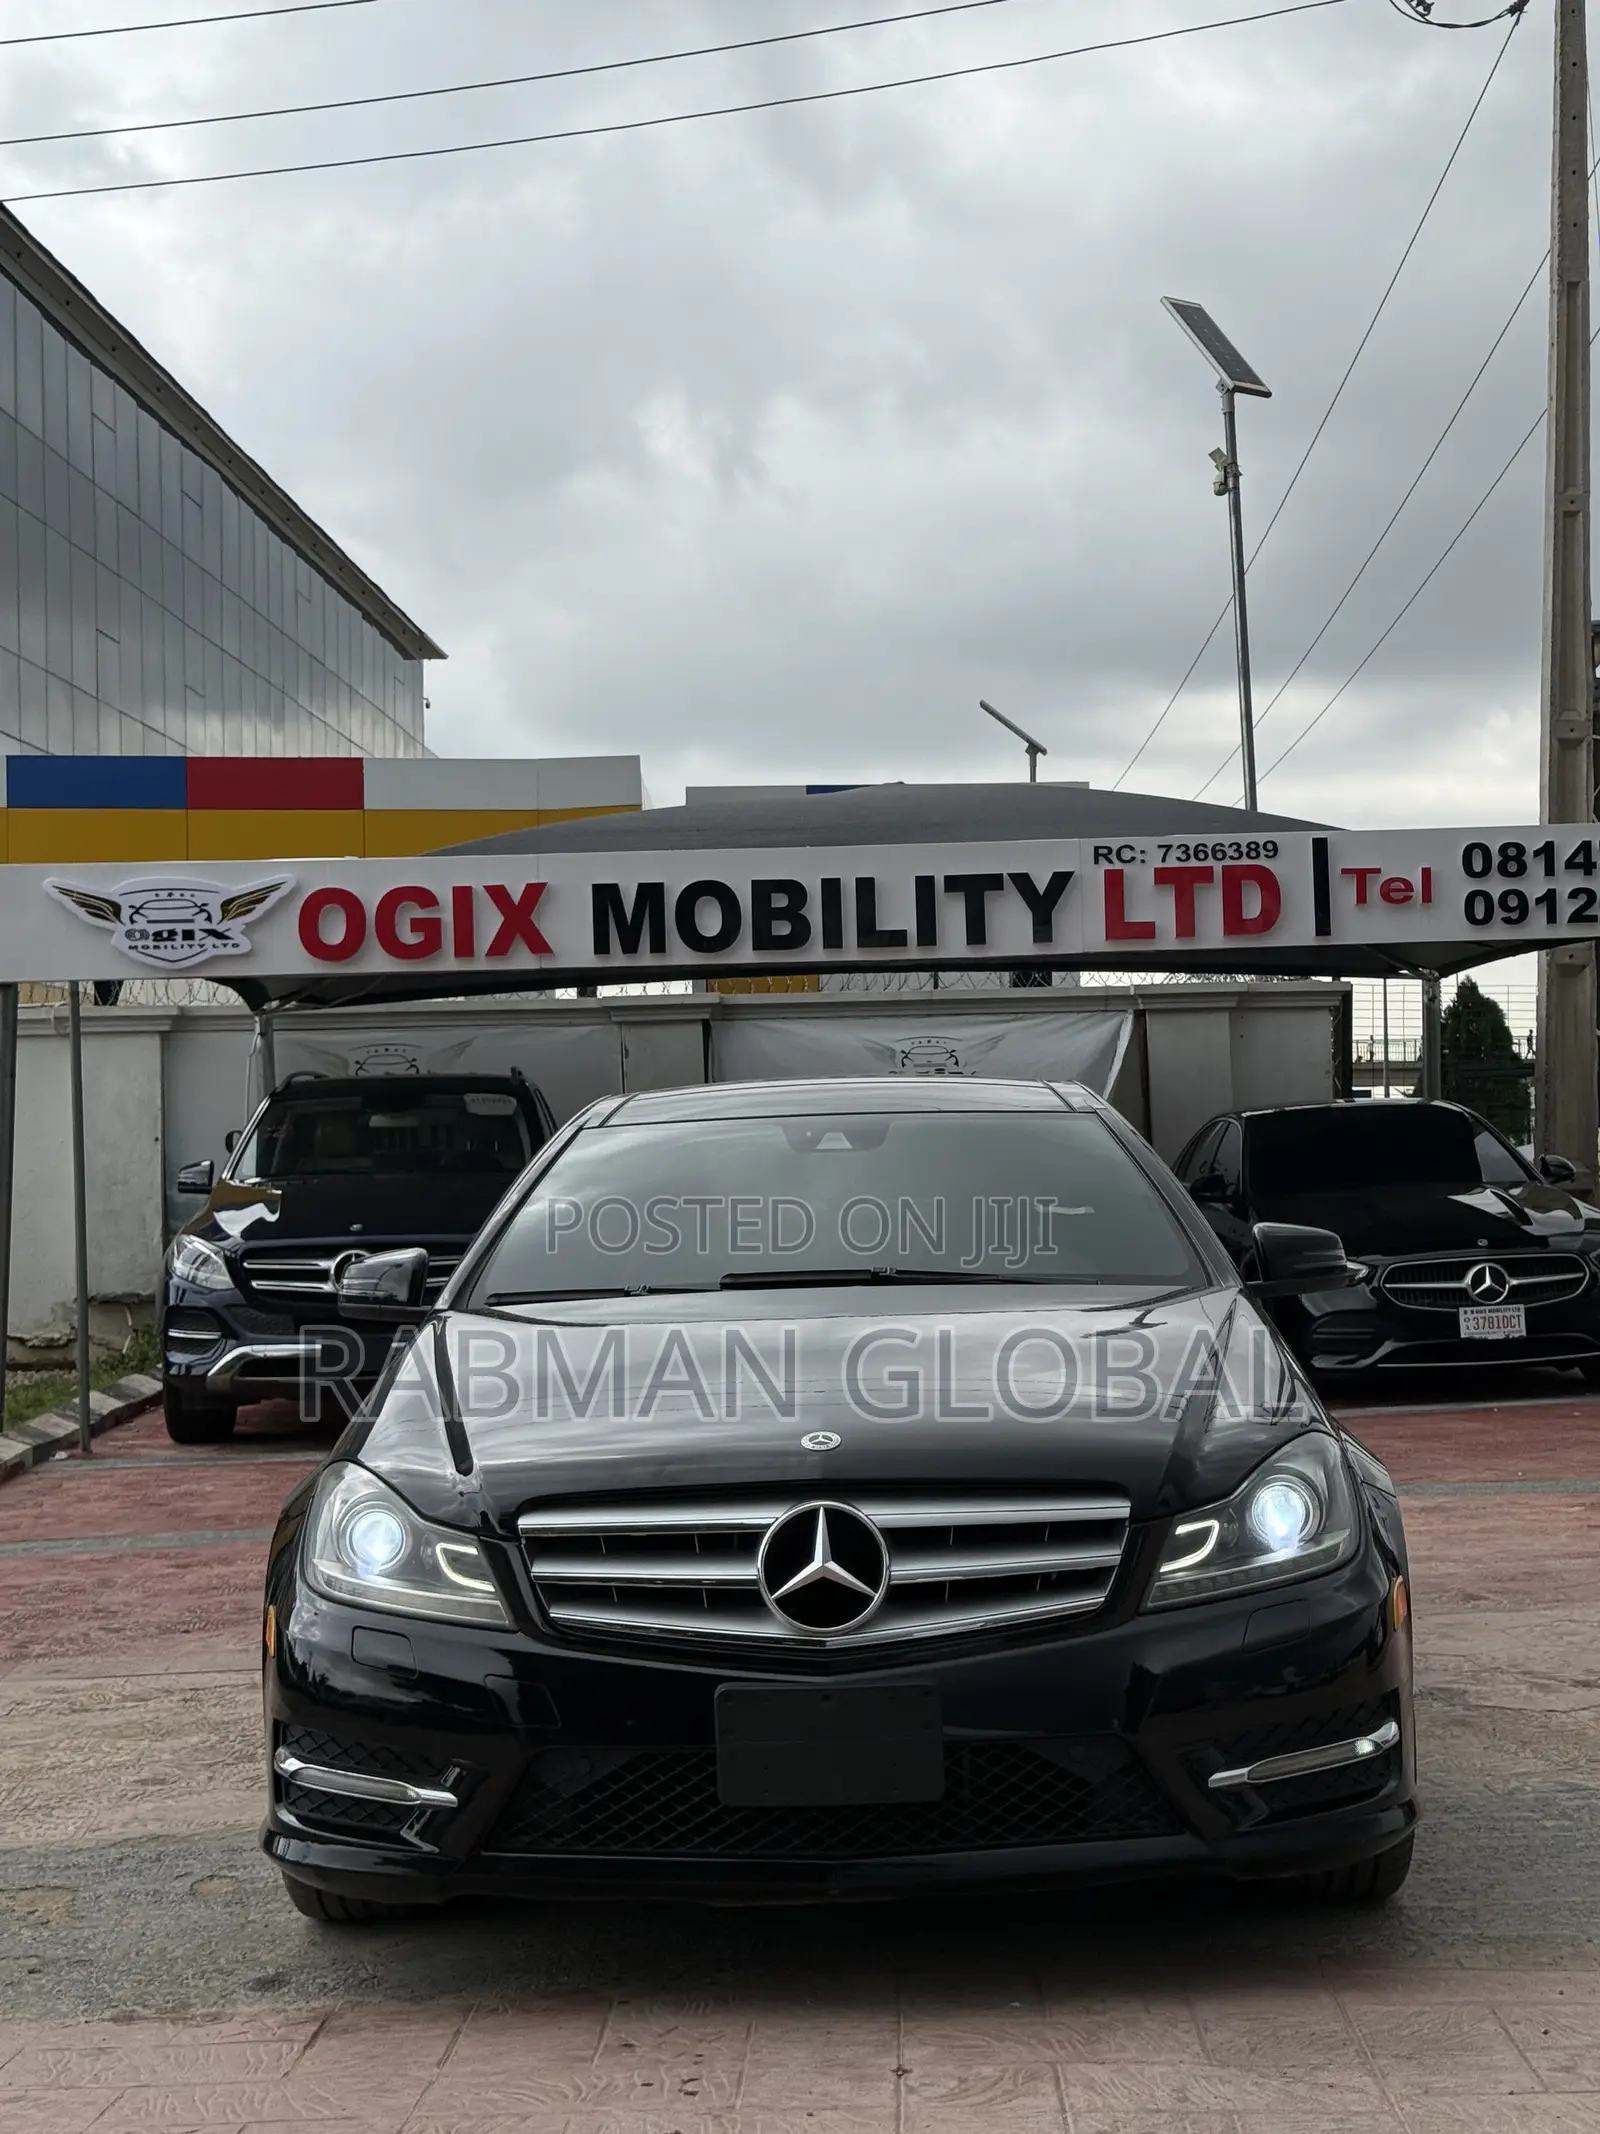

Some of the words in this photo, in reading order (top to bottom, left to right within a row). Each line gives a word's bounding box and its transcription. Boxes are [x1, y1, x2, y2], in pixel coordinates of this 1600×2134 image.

[1093, 844, 1147, 865] RC:
[1157, 839, 1279, 863] 7366389
[1462, 840, 1600, 878] 0814
[1341, 867, 1432, 904] Tel
[298, 882, 554, 962] OGIX
[592, 871, 1074, 955] MOBILITY
[1104, 864, 1281, 941] LTD
[1464, 887, 1600, 926] 0912
[128, 943, 206, 951] MOBILITY
